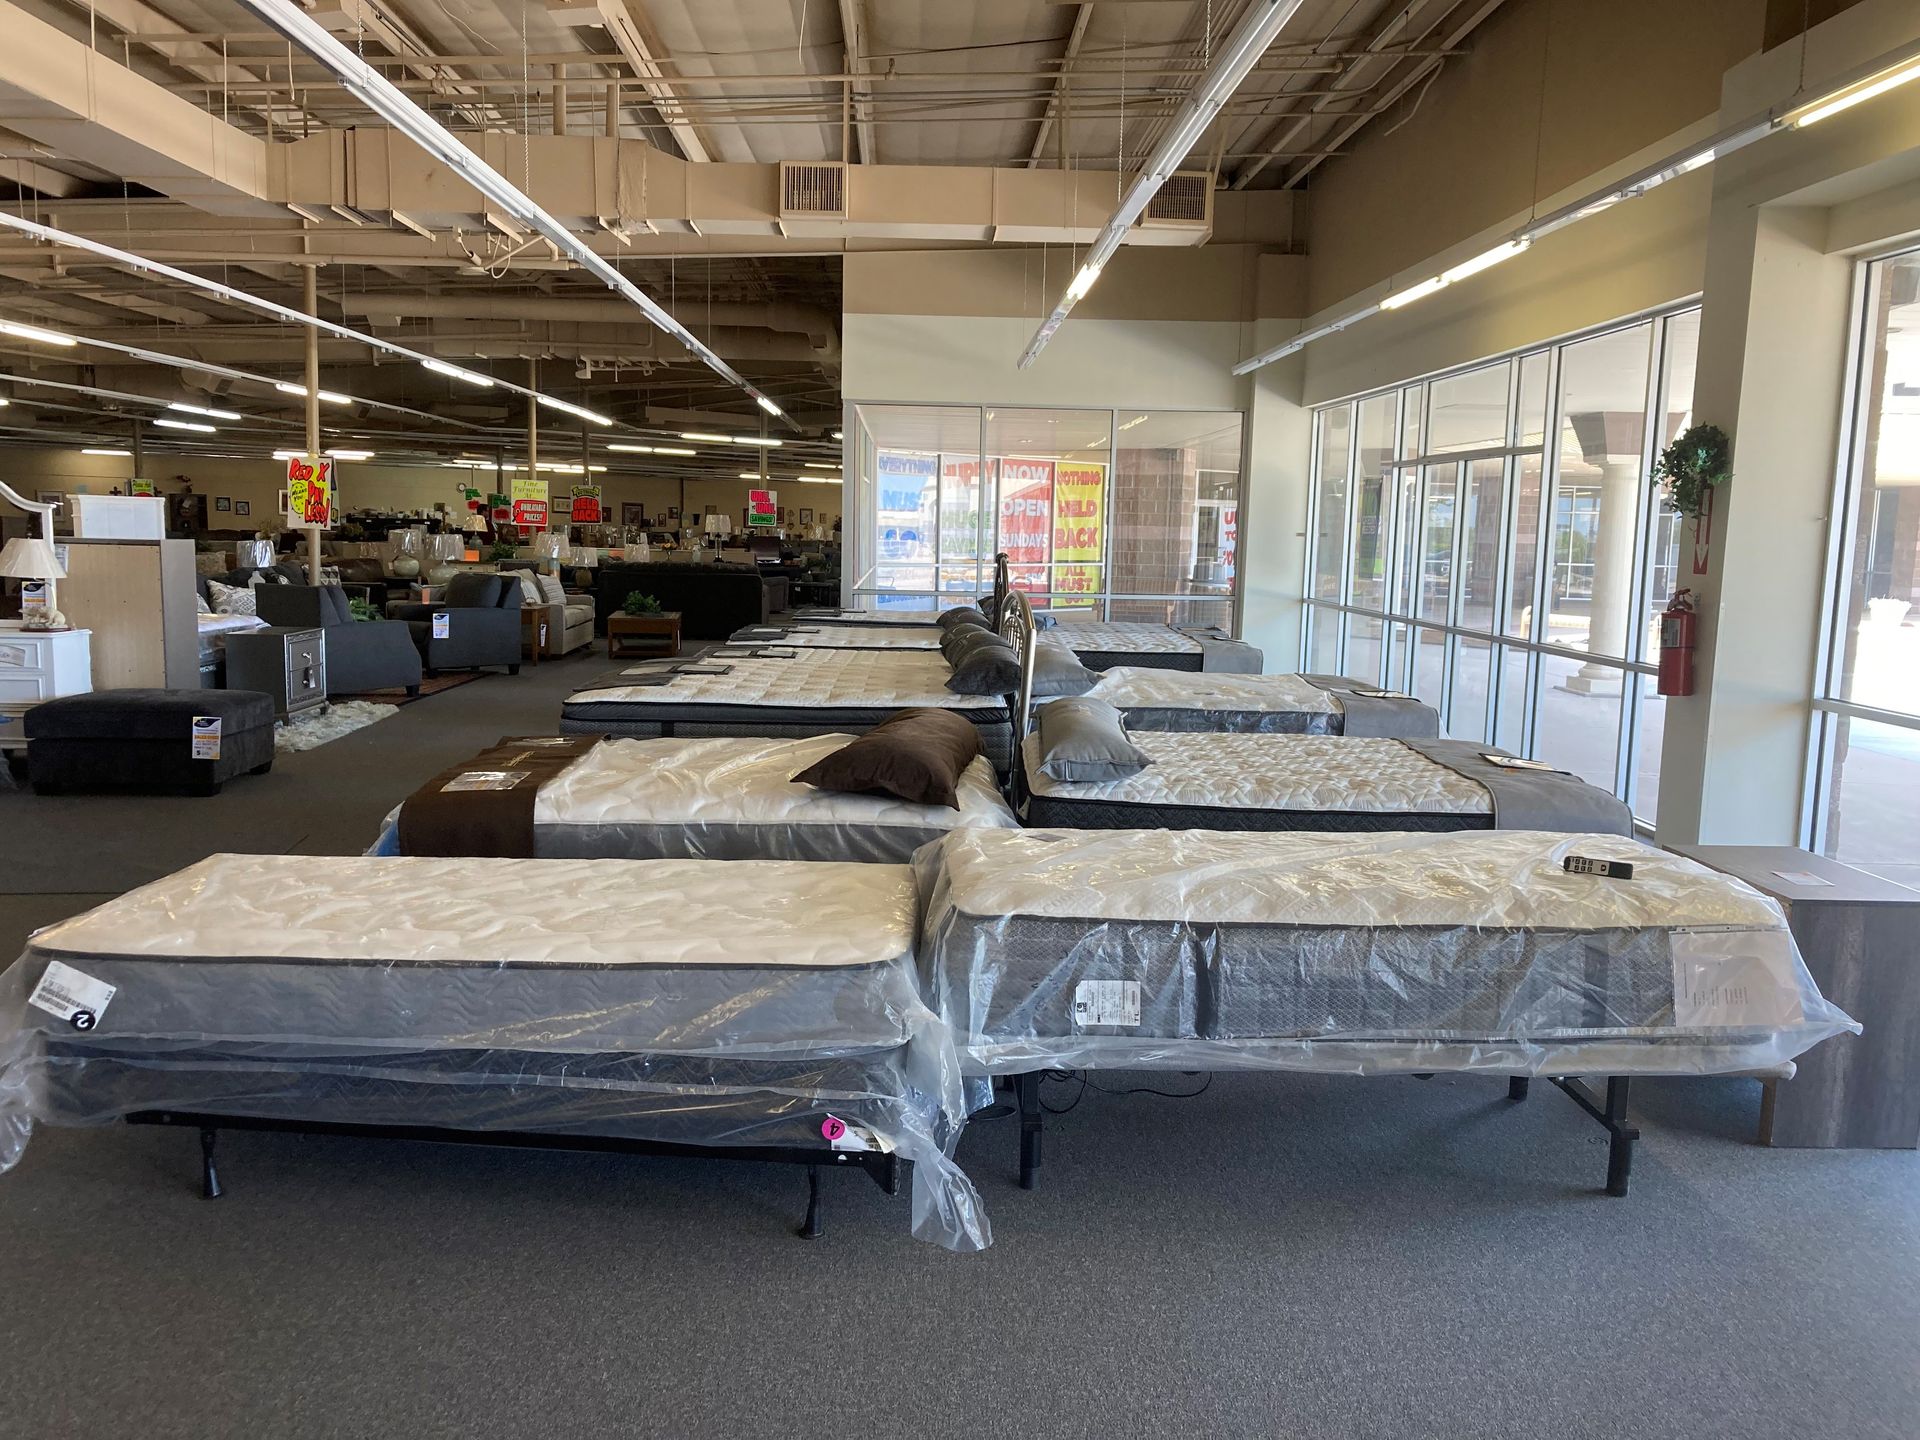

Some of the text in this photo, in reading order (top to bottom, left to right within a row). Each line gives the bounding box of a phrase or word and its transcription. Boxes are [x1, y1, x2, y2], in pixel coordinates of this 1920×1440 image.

[1004, 464, 1049, 483] NOW
[1057, 470, 1101, 486] NOTHING
[1001, 499, 1047, 517] OPEN
[1058, 500, 1098, 517] HELD
[1224, 511, 1236, 525] U
[1000, 533, 1048, 548] SUNDAYS
[1055, 527, 1098, 549] BACK
[1065, 565, 1086, 577] ALL
[1055, 577, 1093, 591] MUST
[77, 1014, 89, 1028] 2
[829, 1122, 840, 1137] 4
